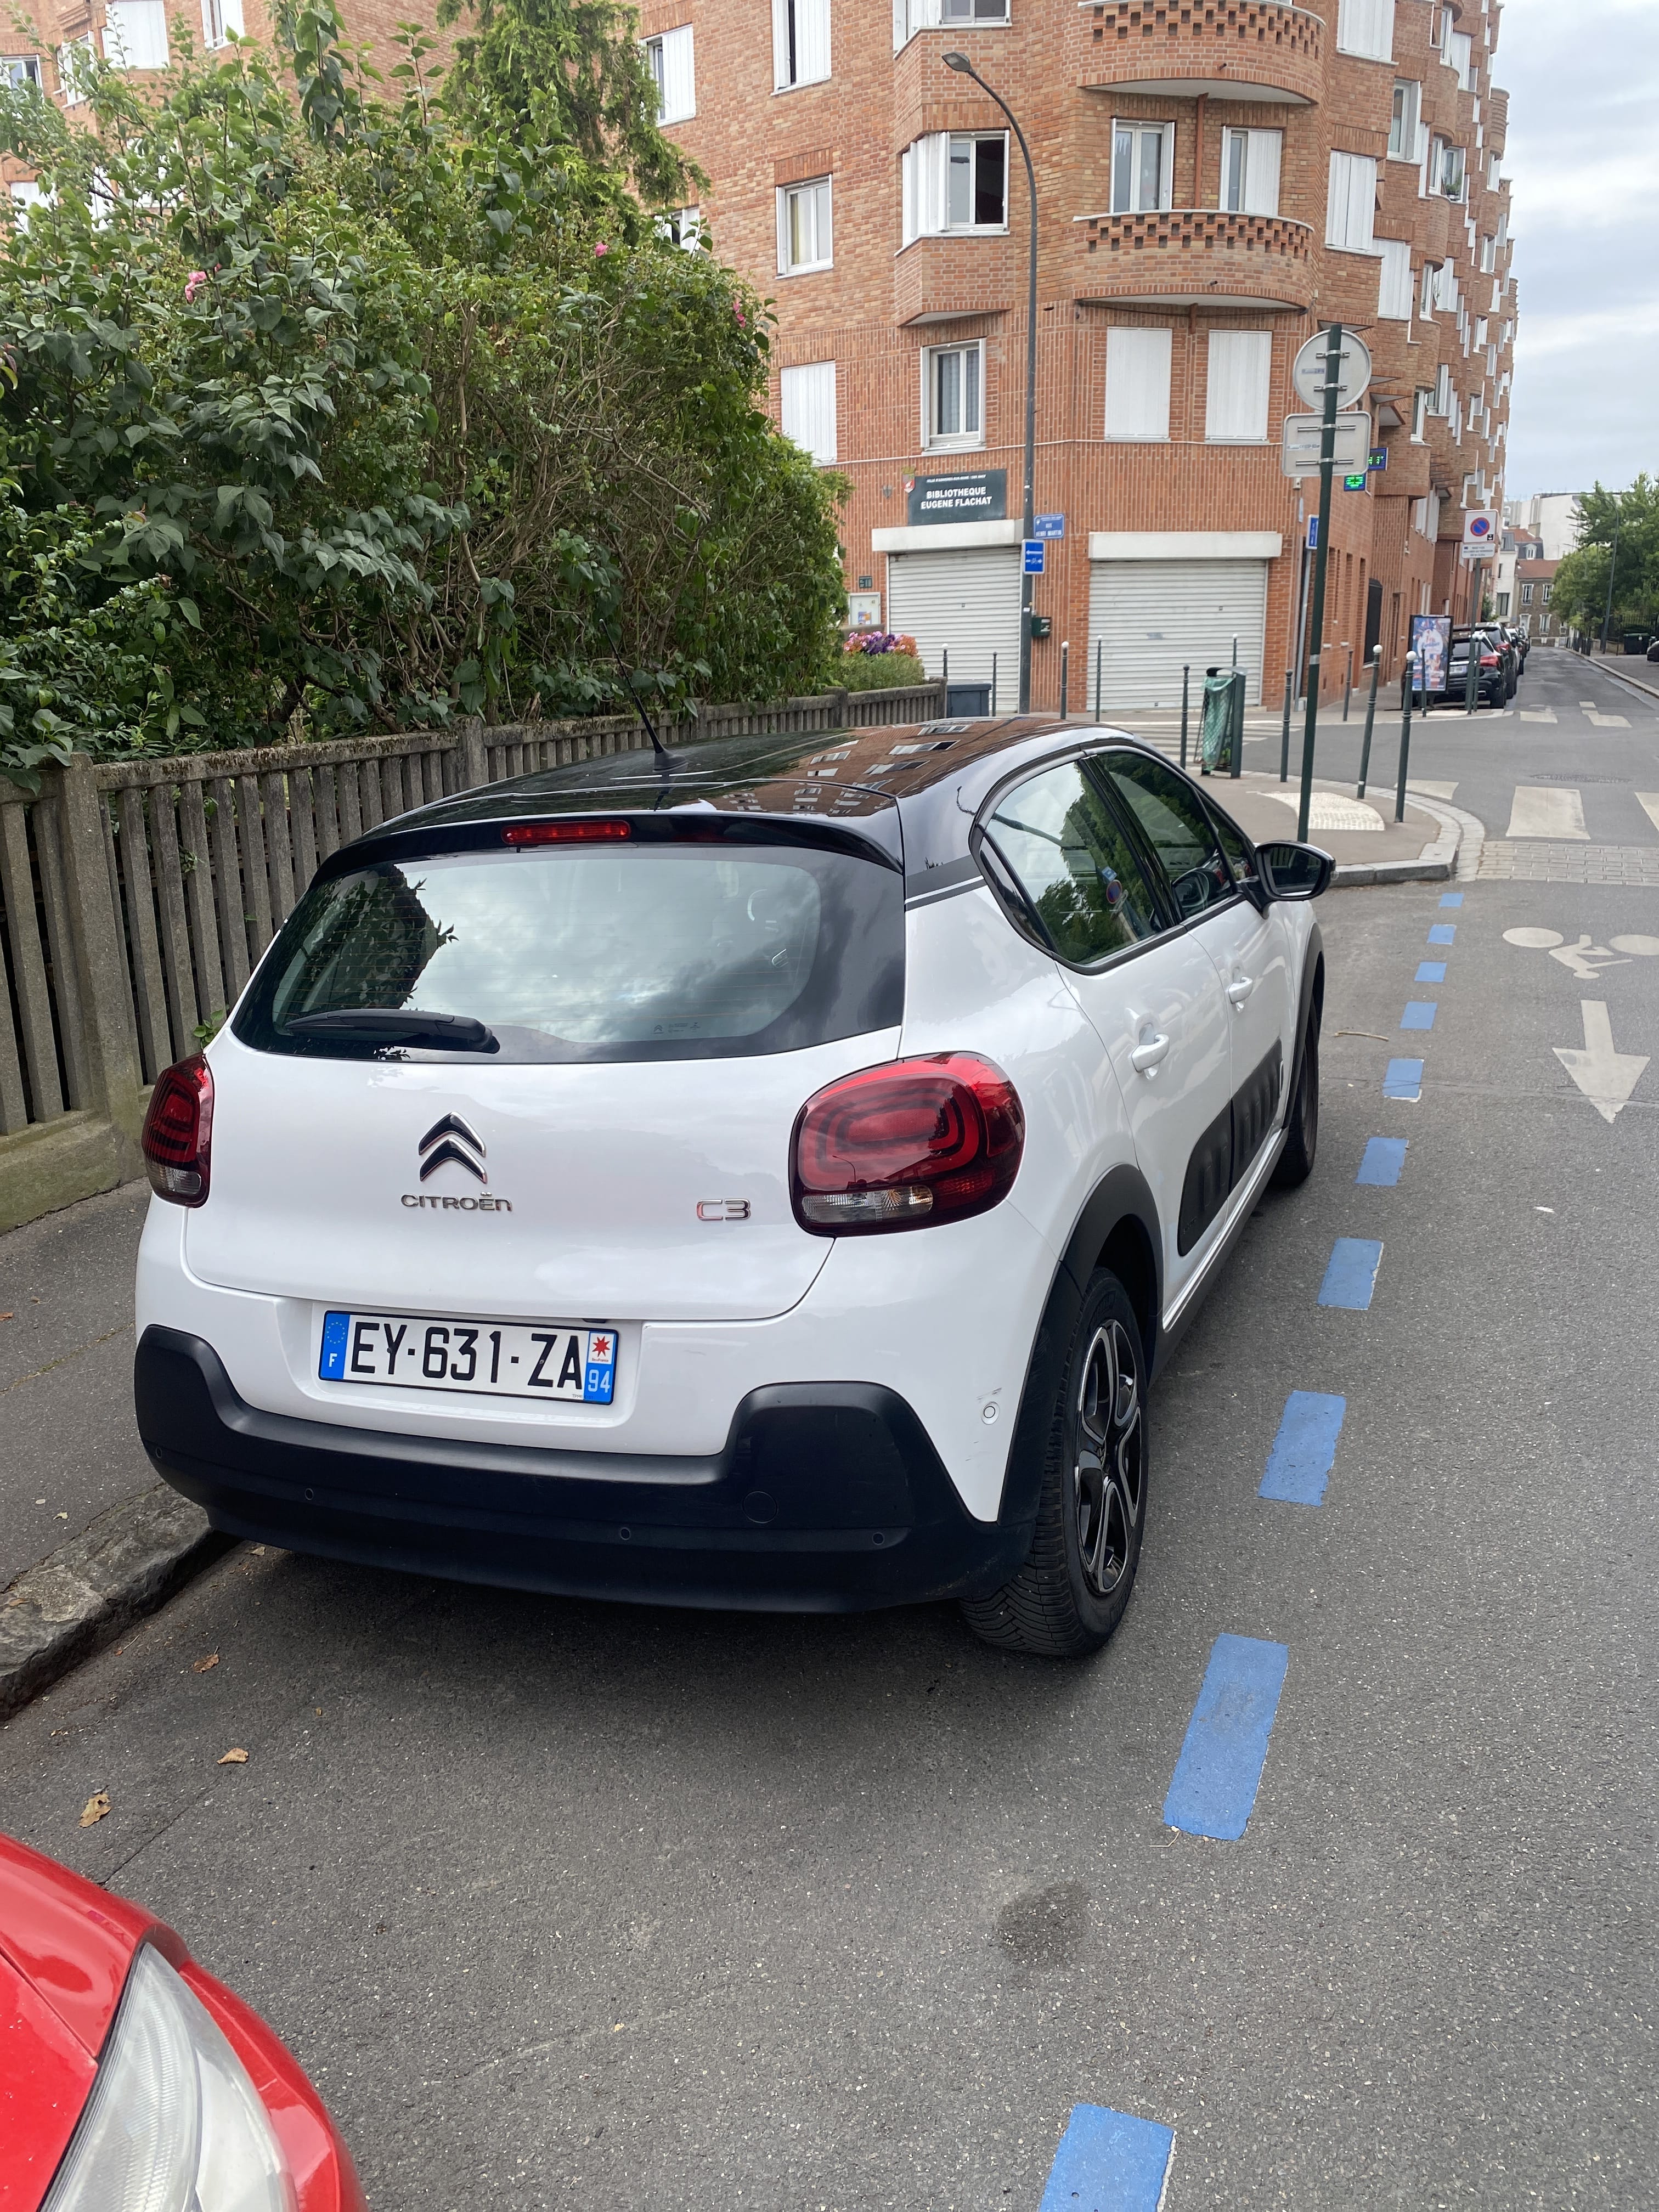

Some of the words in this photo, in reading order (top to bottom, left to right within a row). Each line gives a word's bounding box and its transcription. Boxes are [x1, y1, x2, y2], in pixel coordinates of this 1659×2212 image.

[926, 486, 986, 499] BIBLIOTHEQUE
[921, 499, 953, 510] EUGENE
[955, 496, 992, 506] FLACHAT
[400, 1192, 513, 1211] CITROËN
[696, 1198, 751, 1221] C3
[328, 1352, 338, 1368] F
[588, 1369, 611, 1393] 94
